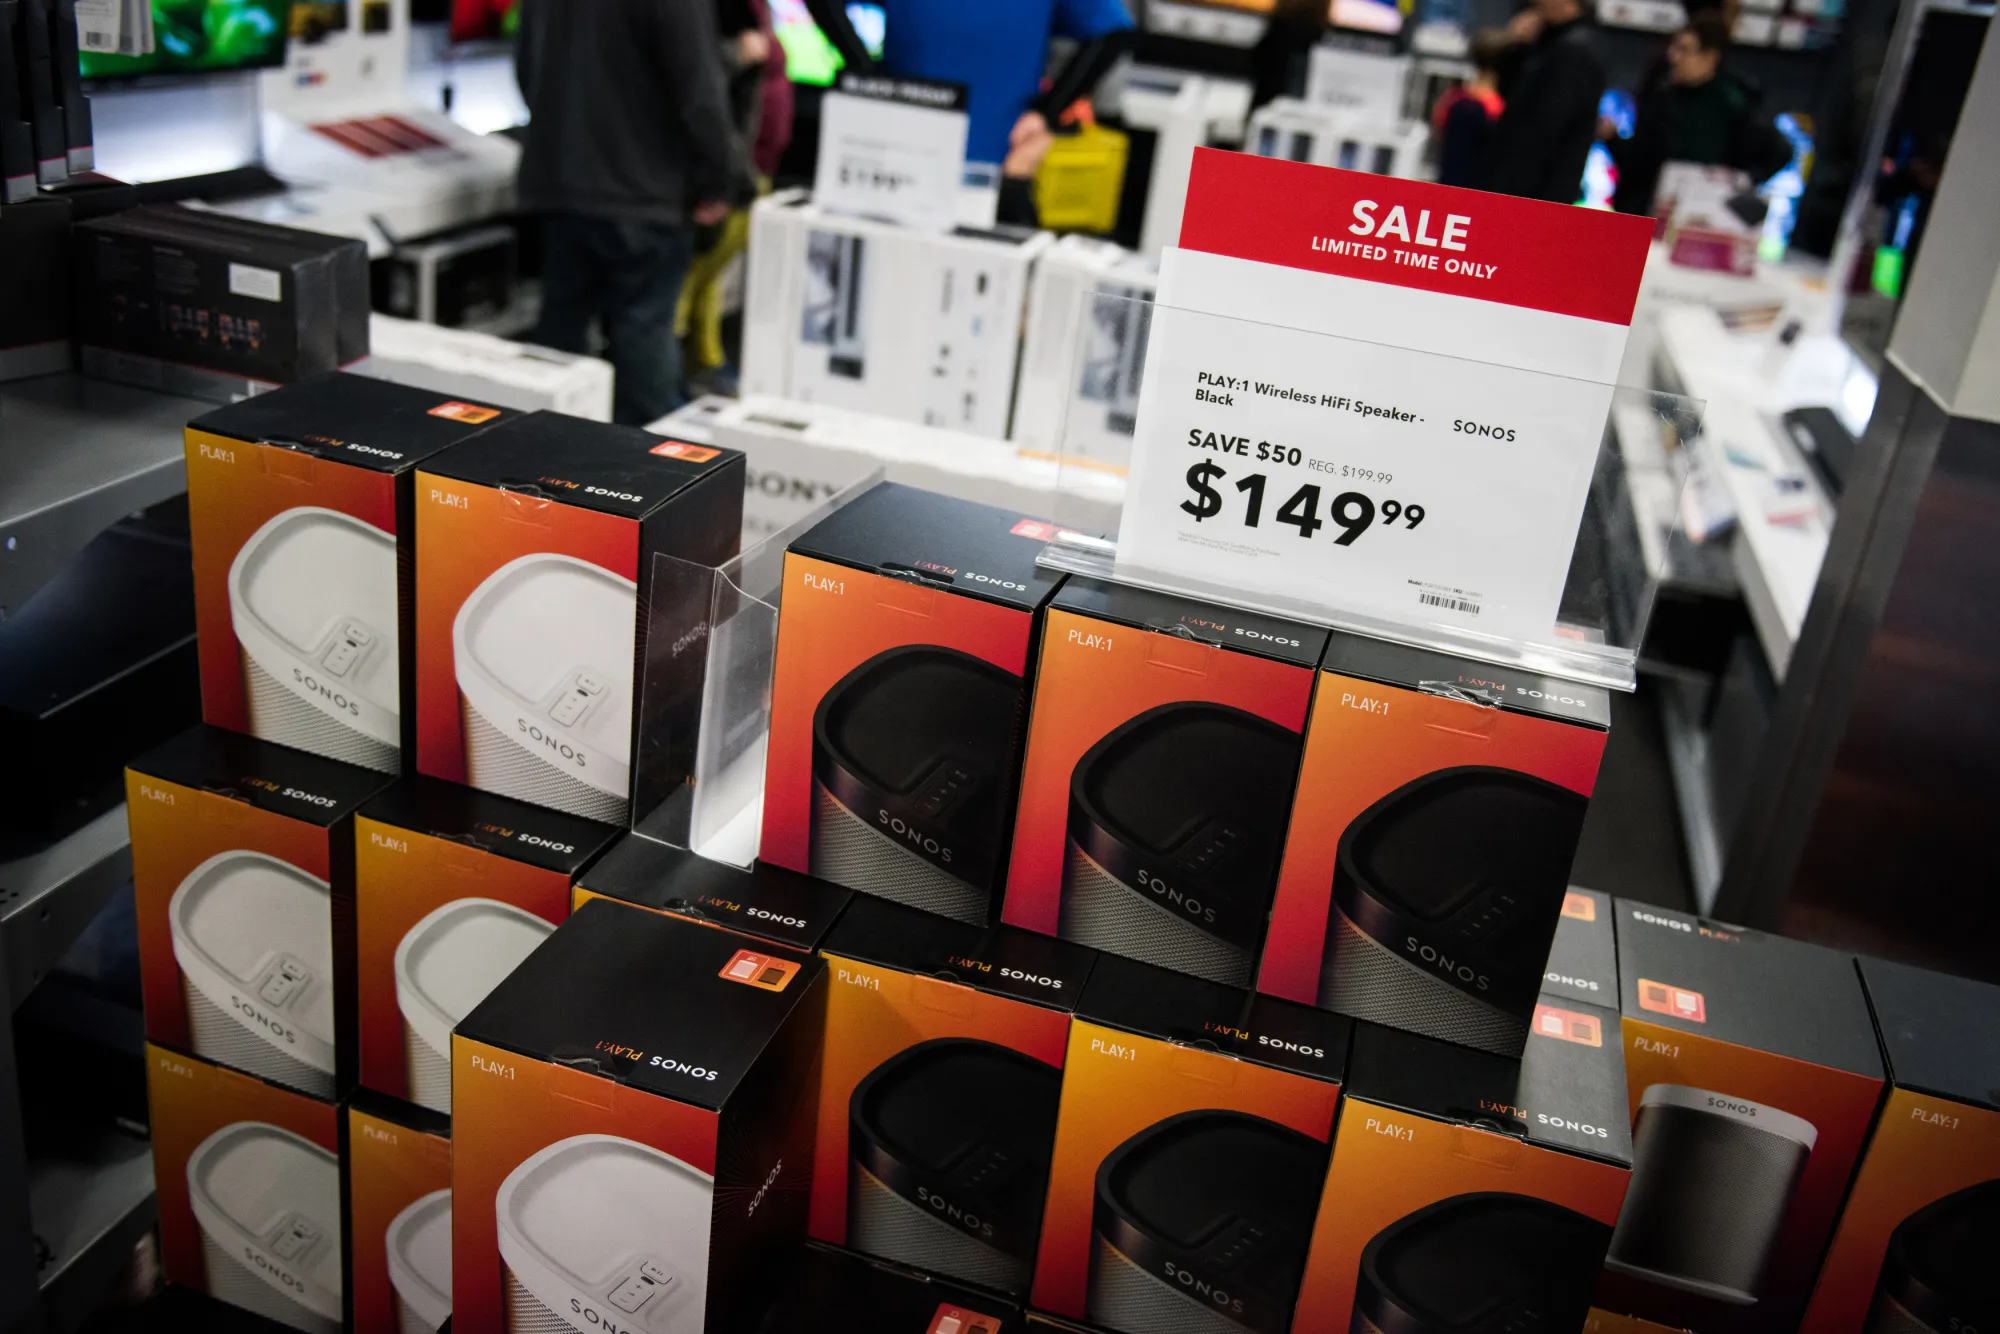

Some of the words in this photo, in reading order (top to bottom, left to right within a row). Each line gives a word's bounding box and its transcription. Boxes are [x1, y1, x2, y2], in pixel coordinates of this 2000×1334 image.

[1348, 199, 1471, 252] SALE
[1311, 236, 1387, 261] LIMITED
[1393, 249, 1439, 271] TIME
[1445, 258, 1498, 280] ONLY
[1195, 388, 1234, 407] Black
[1197, 371, 1250, 392] PLAY:1
[1254, 382, 1317, 405] Wireless
[1320, 394, 1350, 411] HiFi
[1354, 400, 1417, 424] Speaker
[1453, 419, 1516, 443] SONOS
[200, 443, 235, 464] PLAY:1
[347, 443, 404, 460] SONOS
[1187, 428, 1250, 457] SAVE
[1256, 440, 1302, 467] $50
[1308, 458, 1338, 476] REG.
[1341, 464, 1393, 485] $199.99
[431, 489, 468, 510] PLAY:1
[584, 485, 643, 503] SONOS
[804, 573, 845, 595] PLAY:1
[964, 572, 1027, 592] SONOS
[1068, 629, 1113, 652] PLAY:1
[1235, 628, 1300, 647] SONOS
[292, 667, 360, 717] SONOS
[1516, 687, 1586, 708] SONOS
[1341, 693, 1389, 716] PLAY:1
[517, 717, 587, 768] SONOS
[140, 785, 175, 806] PLAY:1
[282, 787, 337, 808] SONOS
[371, 832, 407, 854] PLAY:1
[518, 833, 575, 854] SONOS
[879, 809, 953, 862] SONOS
[1137, 869, 1216, 923] SONOS
[746, 907, 807, 928] SONOS
[1632, 910, 1692, 932] SONOS
[1406, 936, 1490, 990] SONOS
[838, 969, 880, 991] PLAY:1
[1000, 967, 1063, 989] SONOS
[1543, 972, 1599, 991] ONOS
[231, 995, 296, 1044] SONOS
[1091, 1039, 1136, 1061] PLAY:1
[1258, 1035, 1324, 1058] SONOS
[1634, 1036, 1680, 1058] PLAY:1
[472, 1055, 516, 1080] PLAY:1
[649, 1055, 719, 1081] SONOS
[1707, 1097, 1757, 1117] SONOS
[1911, 1107, 1960, 1130] PLAY:1
[363, 1124, 398, 1145] PLAY:1
[1365, 1118, 1414, 1141] PLAY:1
[1537, 1113, 1608, 1138] SONOS
[748, 1158, 782, 1217] SONOS
[917, 1186, 993, 1236] SONOS
[244, 1247, 305, 1293] SONOS
[1164, 1261, 1244, 1313] SONOS
[570, 1298, 631, 1334] SON
